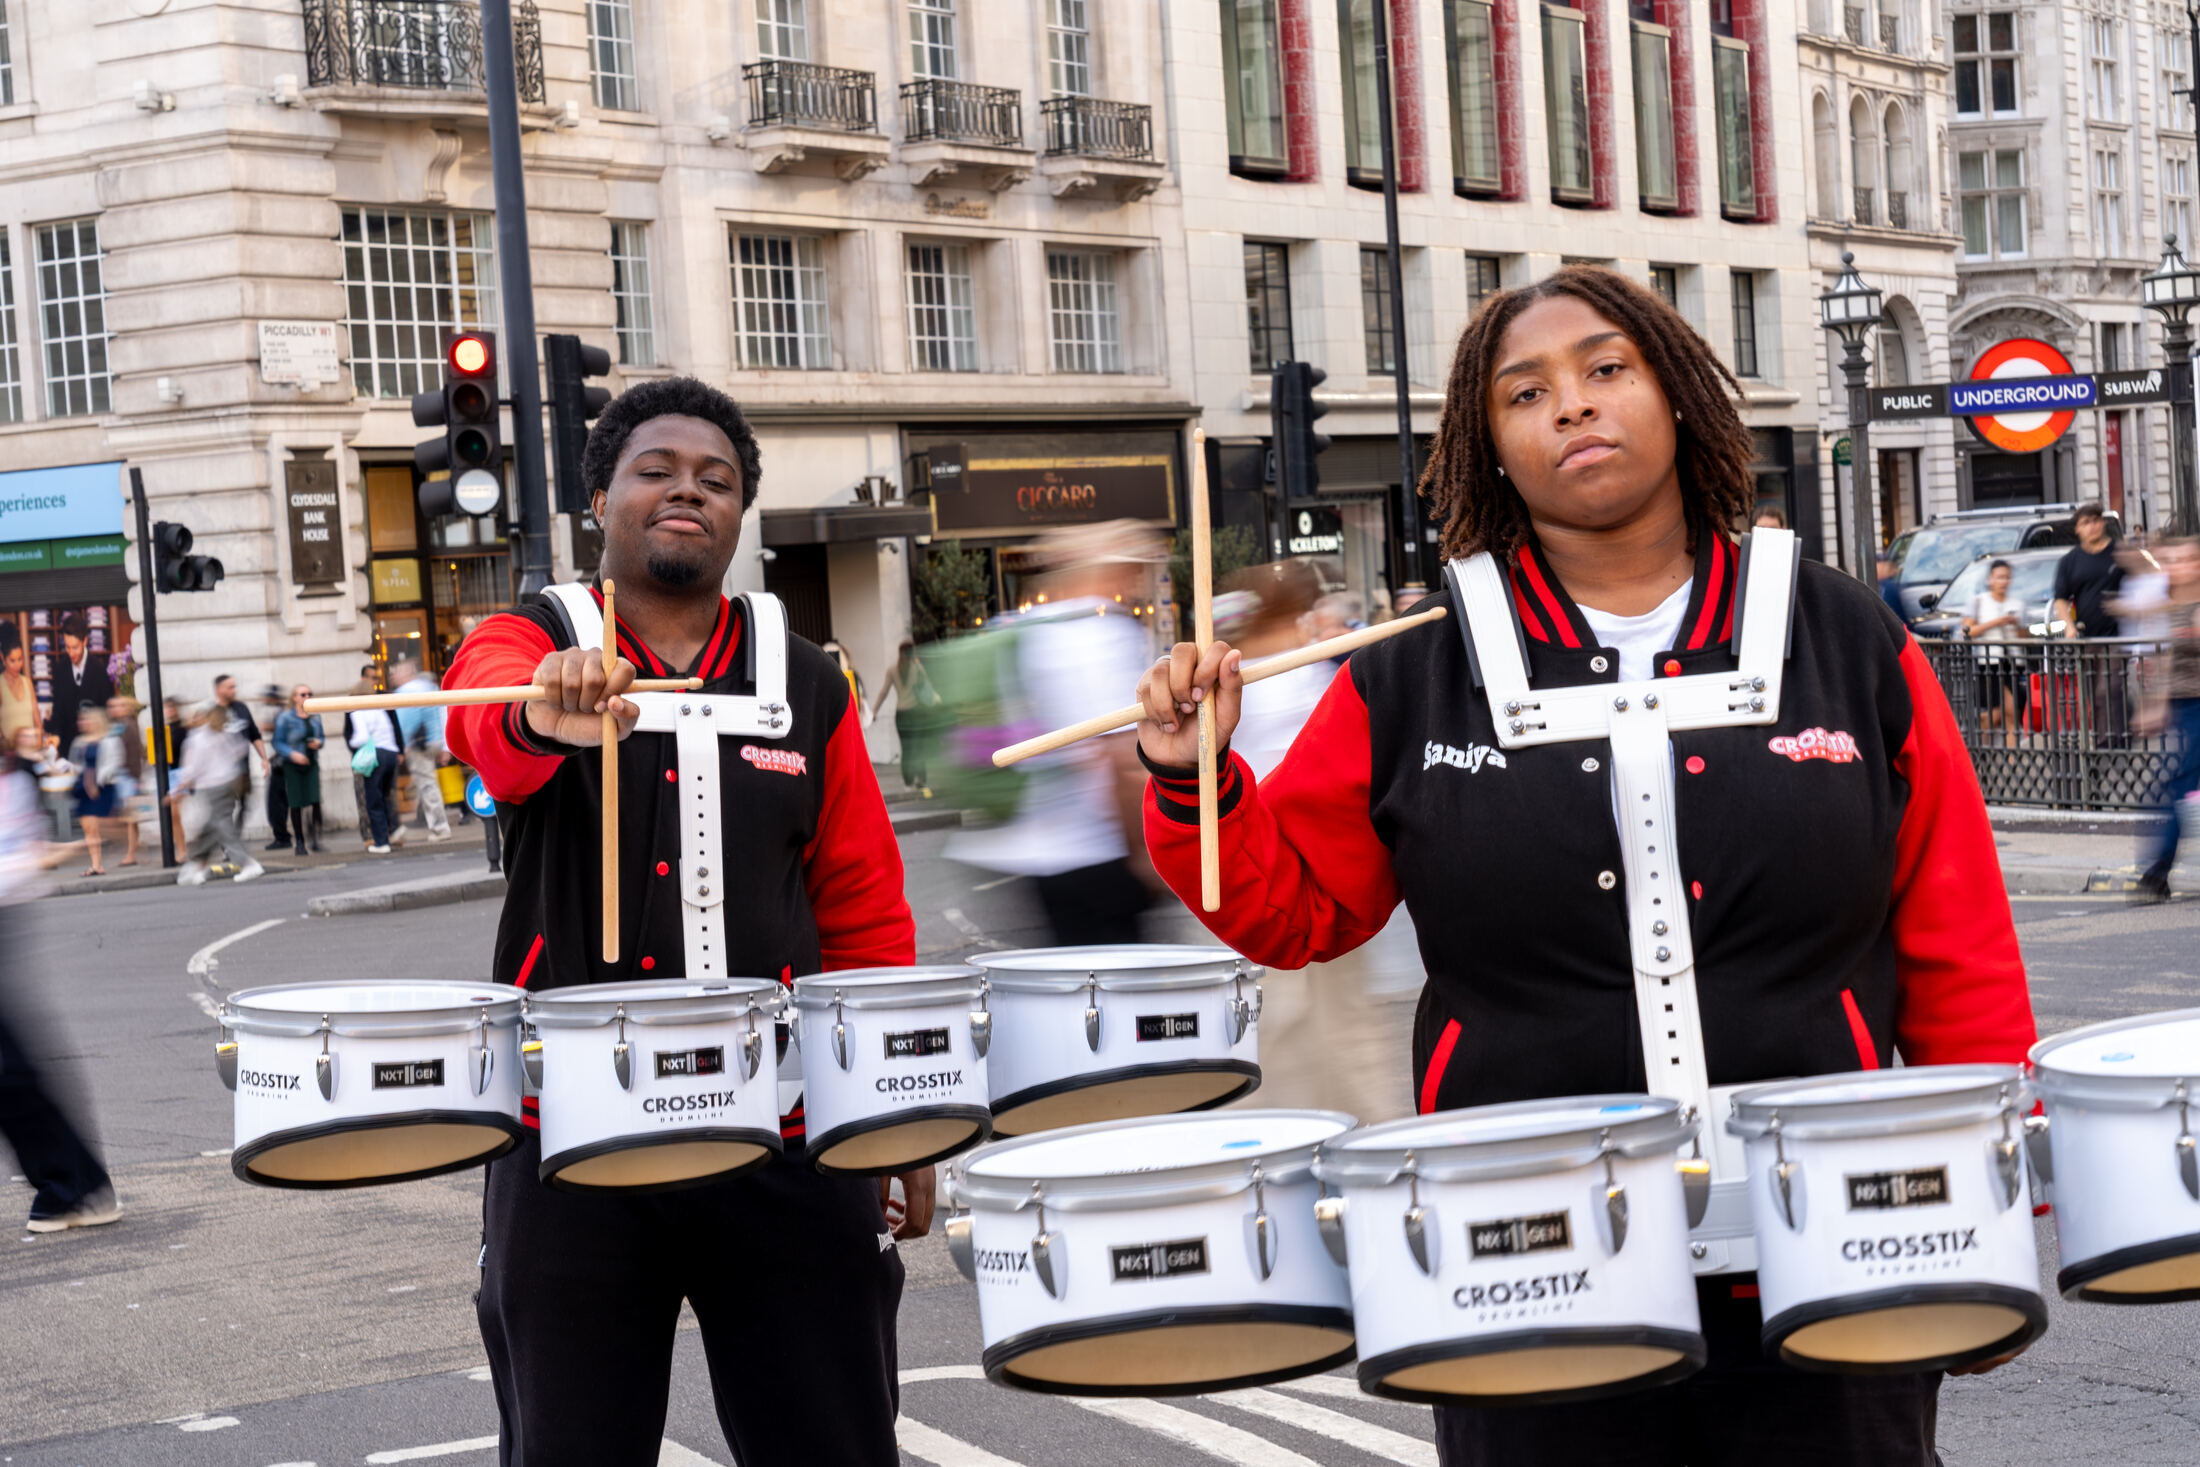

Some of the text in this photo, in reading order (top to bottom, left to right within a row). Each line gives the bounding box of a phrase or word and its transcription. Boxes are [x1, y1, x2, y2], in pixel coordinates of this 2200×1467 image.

[264, 325, 316, 336] PICCADILLY
[1882, 372, 2161, 410] PUBLIC UNDERGROUND SUBWAY
[290, 493, 337, 507] CLYDESDALE
[1017, 484, 1096, 512] CICCARO
[303, 511, 326, 524] BANK
[302, 528, 330, 541] HOUSE
[1274, 535, 1338, 554] SACKLETON
[742, 746, 806, 772] CROSSTIX
[1423, 740, 1507, 774] Saniya
[1175, 1020, 1194, 1032] GEN
[892, 1035, 945, 1050] NXT GEN
[662, 1057, 686, 1070] NXT
[241, 1069, 301, 1090] CROSSTIX
[380, 1067, 437, 1081] NXT GEN
[875, 1069, 963, 1092] CROSSTIX
[642, 1090, 736, 1113] CROSSTIX
[1907, 1177, 1941, 1197] GEN
[1842, 1227, 1979, 1262] CROSSTIX
[1119, 1248, 1200, 1272] NXT GEN
[1453, 1268, 1592, 1308] CROSSTIX
